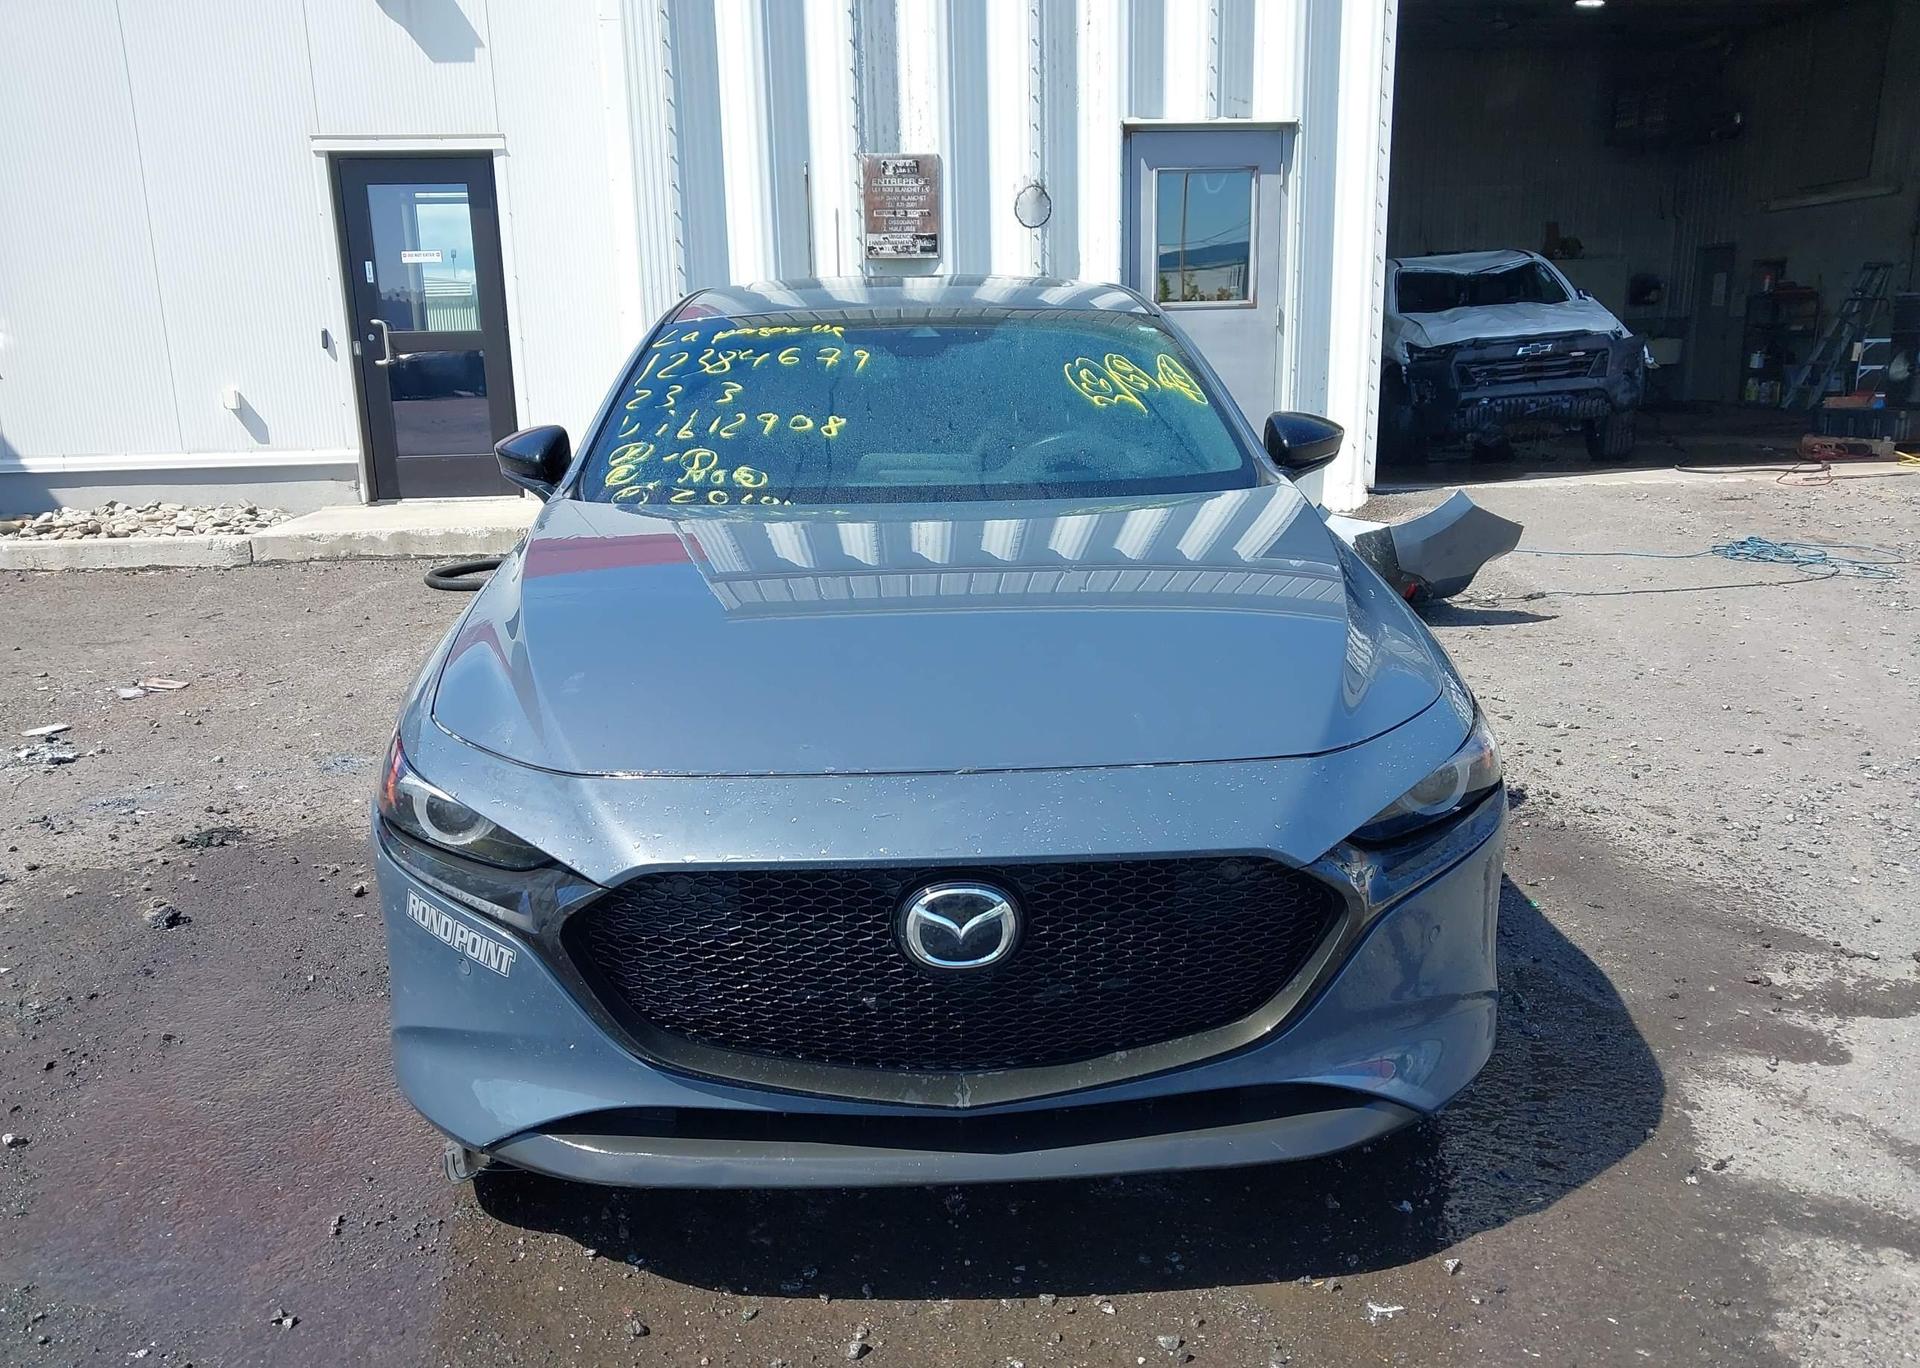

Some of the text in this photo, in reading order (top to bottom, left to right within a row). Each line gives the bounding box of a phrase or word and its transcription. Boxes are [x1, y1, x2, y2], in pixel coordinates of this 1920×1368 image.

[716, 381, 744, 403] 3
[407, 890, 516, 977] ROND POINT
